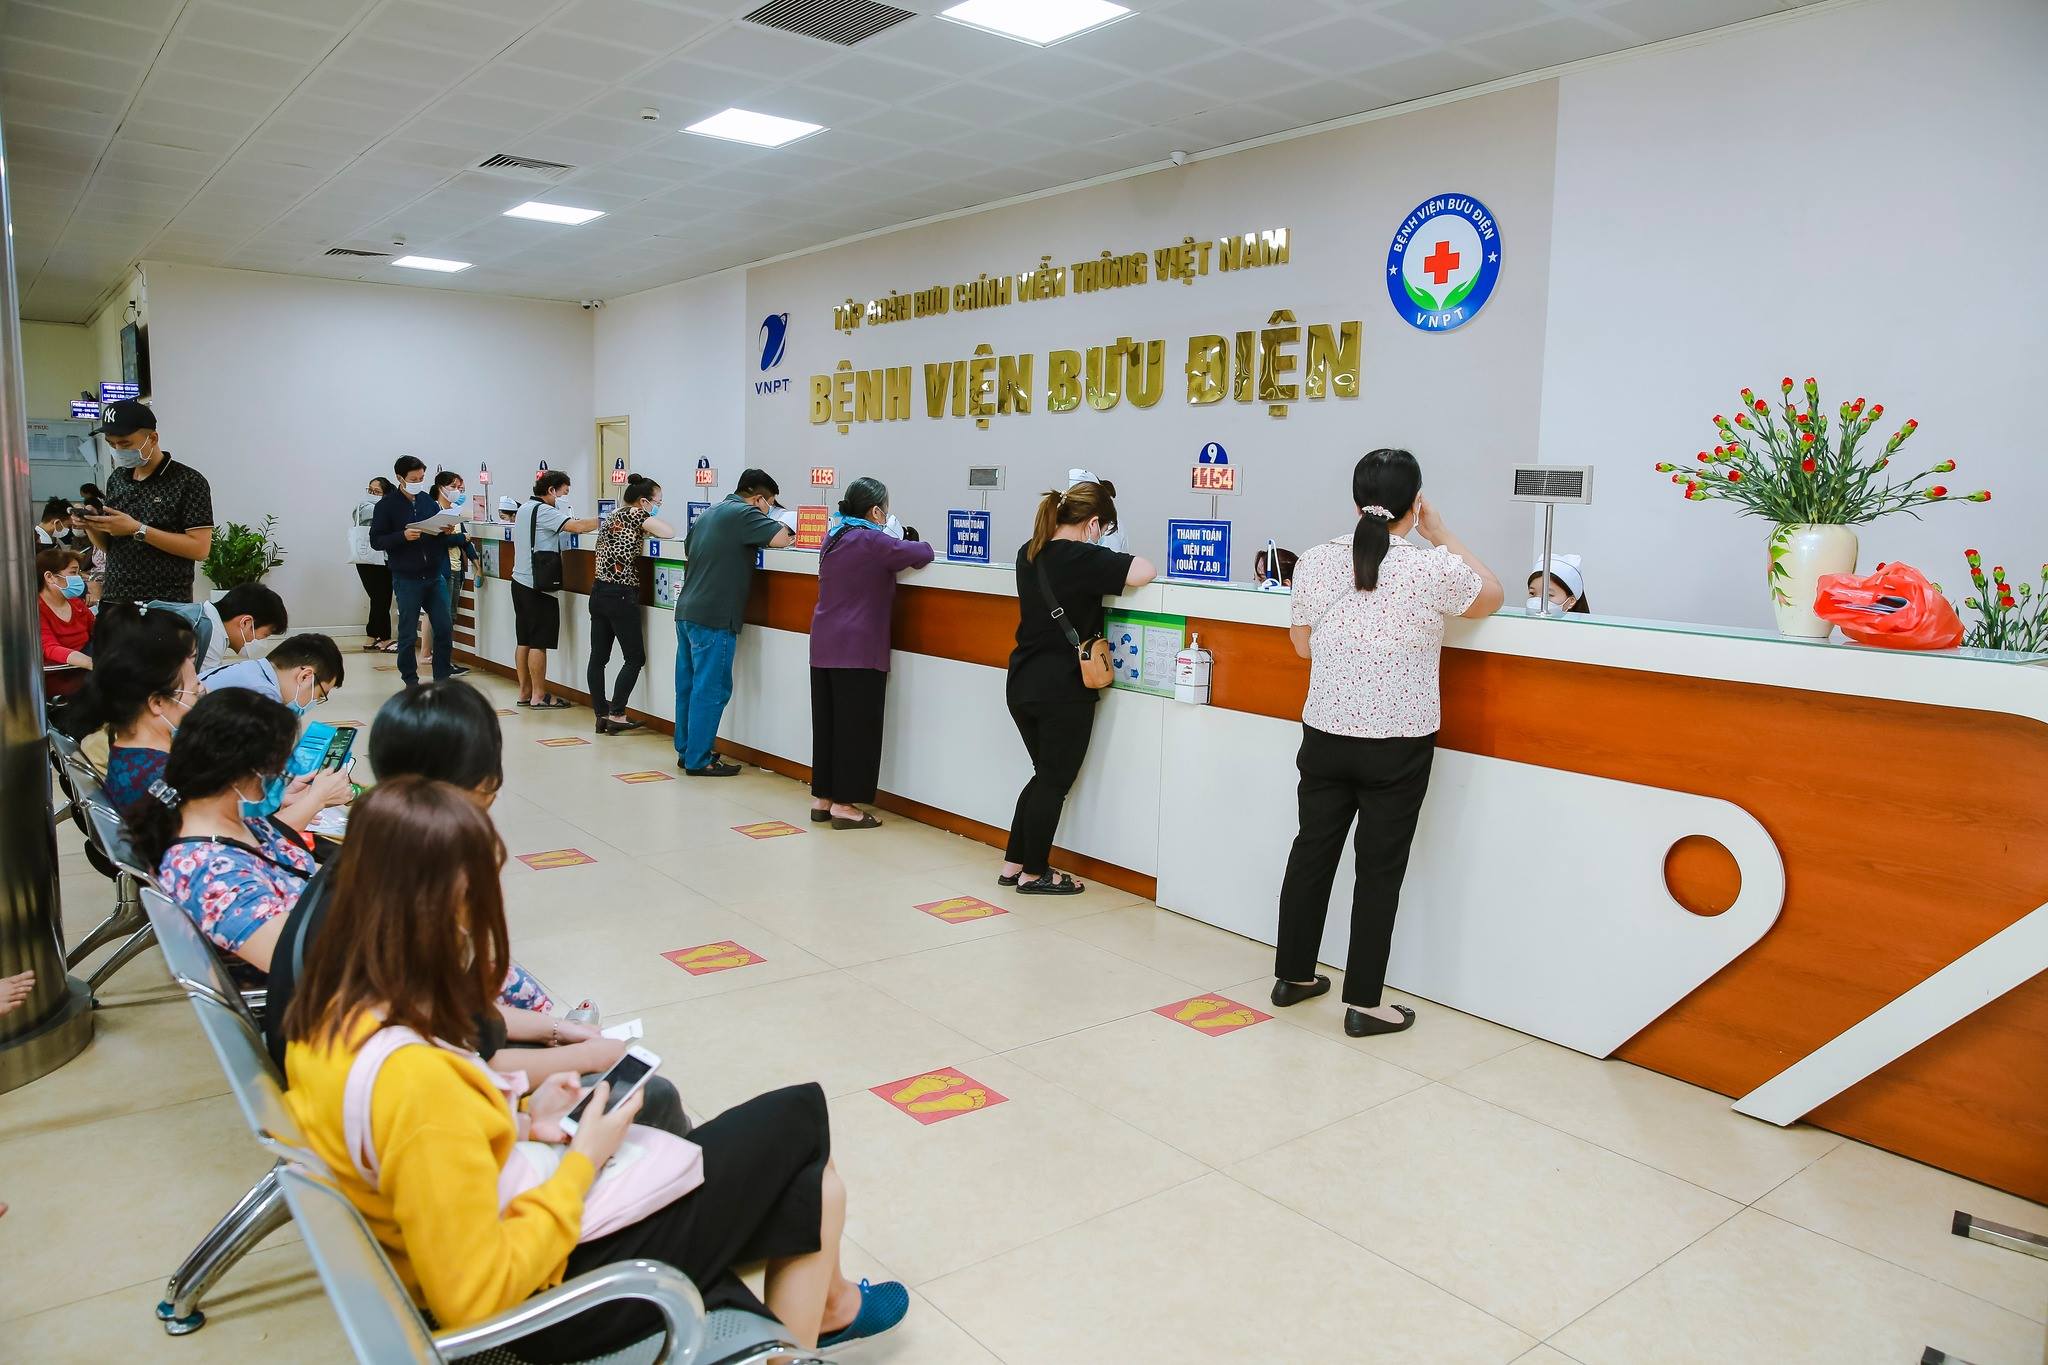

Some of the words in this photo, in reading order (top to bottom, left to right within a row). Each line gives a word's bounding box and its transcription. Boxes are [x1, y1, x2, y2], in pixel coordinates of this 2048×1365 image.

[1393, 216, 1418, 253] BỆNH
[1417, 199, 1445, 219] VIỆN
[1447, 198, 1474, 214] BƯU
[1471, 208, 1495, 241] ĐIỆN
[832, 298, 865, 335] TẬP
[867, 289, 912, 326] ĐOÀN
[914, 285, 950, 319] BƯU
[953, 273, 1013, 312] CHÍNH
[1016, 255, 1067, 303] VIỄN
[1071, 250, 1148, 294] THÔNG
[1154, 236, 1213, 285] VIỆT
[1219, 228, 1291, 272] NAM
[1416, 307, 1465, 328] VNPT
[809, 359, 913, 435] BỆNH
[923, 343, 1034, 429] VIỆN
[1047, 336, 1166, 414] BƯU
[1184, 309, 1364, 418] ĐIỆN
[755, 378, 790, 395] VNPT
[1207, 443, 1218, 464] 9
[812, 468, 833, 485] 1155
[1193, 467, 1233, 489] 1154
[953, 518, 970, 528] THANH
[1177, 528, 1200, 540] THANH
[1202, 528, 1222, 541] TOÁN
[1183, 543, 1200, 557] VIỆN
[1201, 543, 1215, 557] PHÍ
[1199, 560, 1221, 573] 7,8,9)
